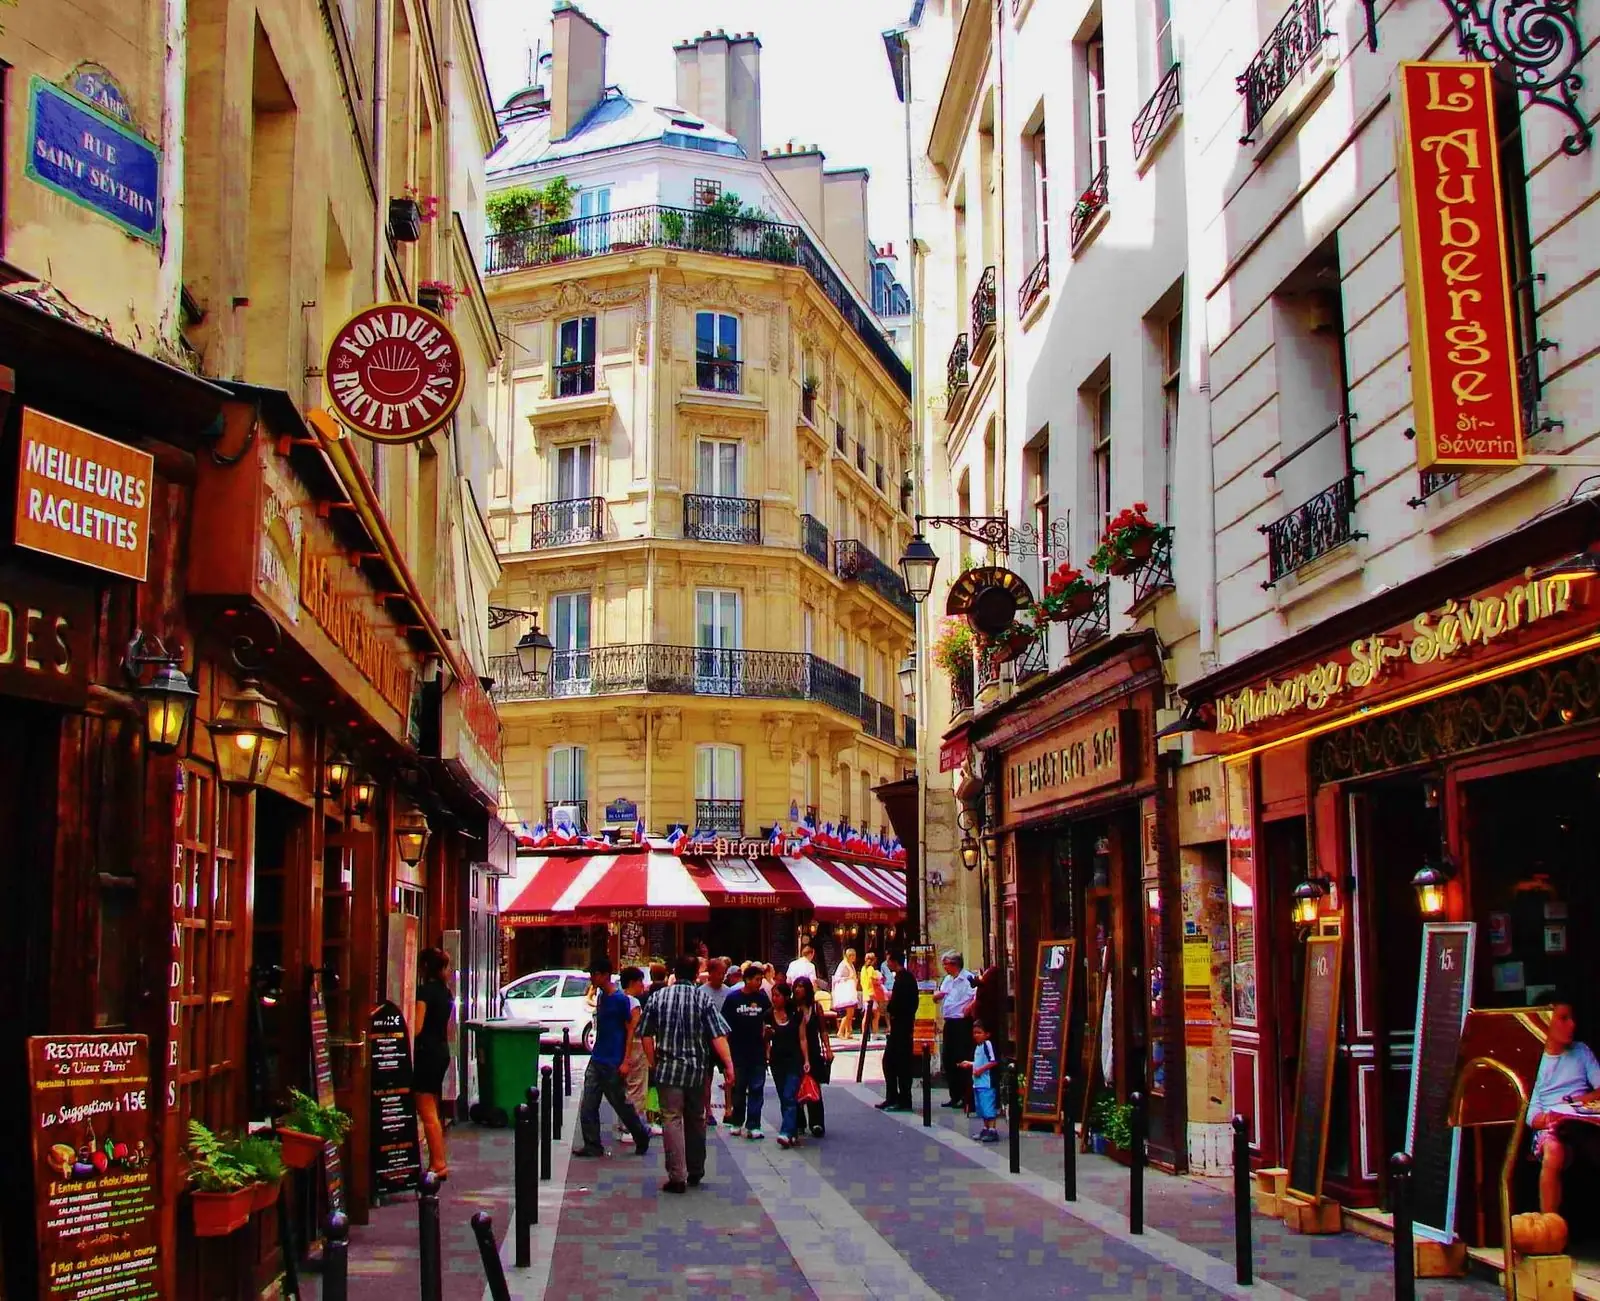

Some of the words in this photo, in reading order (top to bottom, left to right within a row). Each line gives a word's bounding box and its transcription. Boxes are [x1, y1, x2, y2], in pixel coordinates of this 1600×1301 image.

[82, 131, 116, 165] RUE
[36, 138, 84, 179] SAINT
[89, 167, 154, 217] SÉVERIN
[1420, 72, 1493, 406] L'Auberge
[340, 312, 453, 361] FONDUES
[333, 370, 453, 430] RACLETTES
[1438, 433, 1515, 455] Séverin
[26, 439, 146, 509] MEILLEURES
[28, 487, 138, 551] RACLETTES
[1216, 661, 1342, 734] L'Auberge
[1411, 567, 1570, 664] Séverin
[739, 894, 780, 906] Prégrille
[167, 844, 183, 1107] FONDUES
[45, 1041, 137, 1060] RESTAURANT
[72, 1061, 100, 1074] Vieux
[41, 1112, 56, 1128] La
[58, 1099, 114, 1124] Suggestion
[123, 1090, 147, 1112] 15€
[49, 1182, 56, 1196] 1
[58, 1182, 83, 1194] Entrée
[85, 1181, 97, 1190] au
[50, 1262, 57, 1277] 1
[58, 1262, 73, 1274] Plat
[77, 1260, 87, 1269] au
